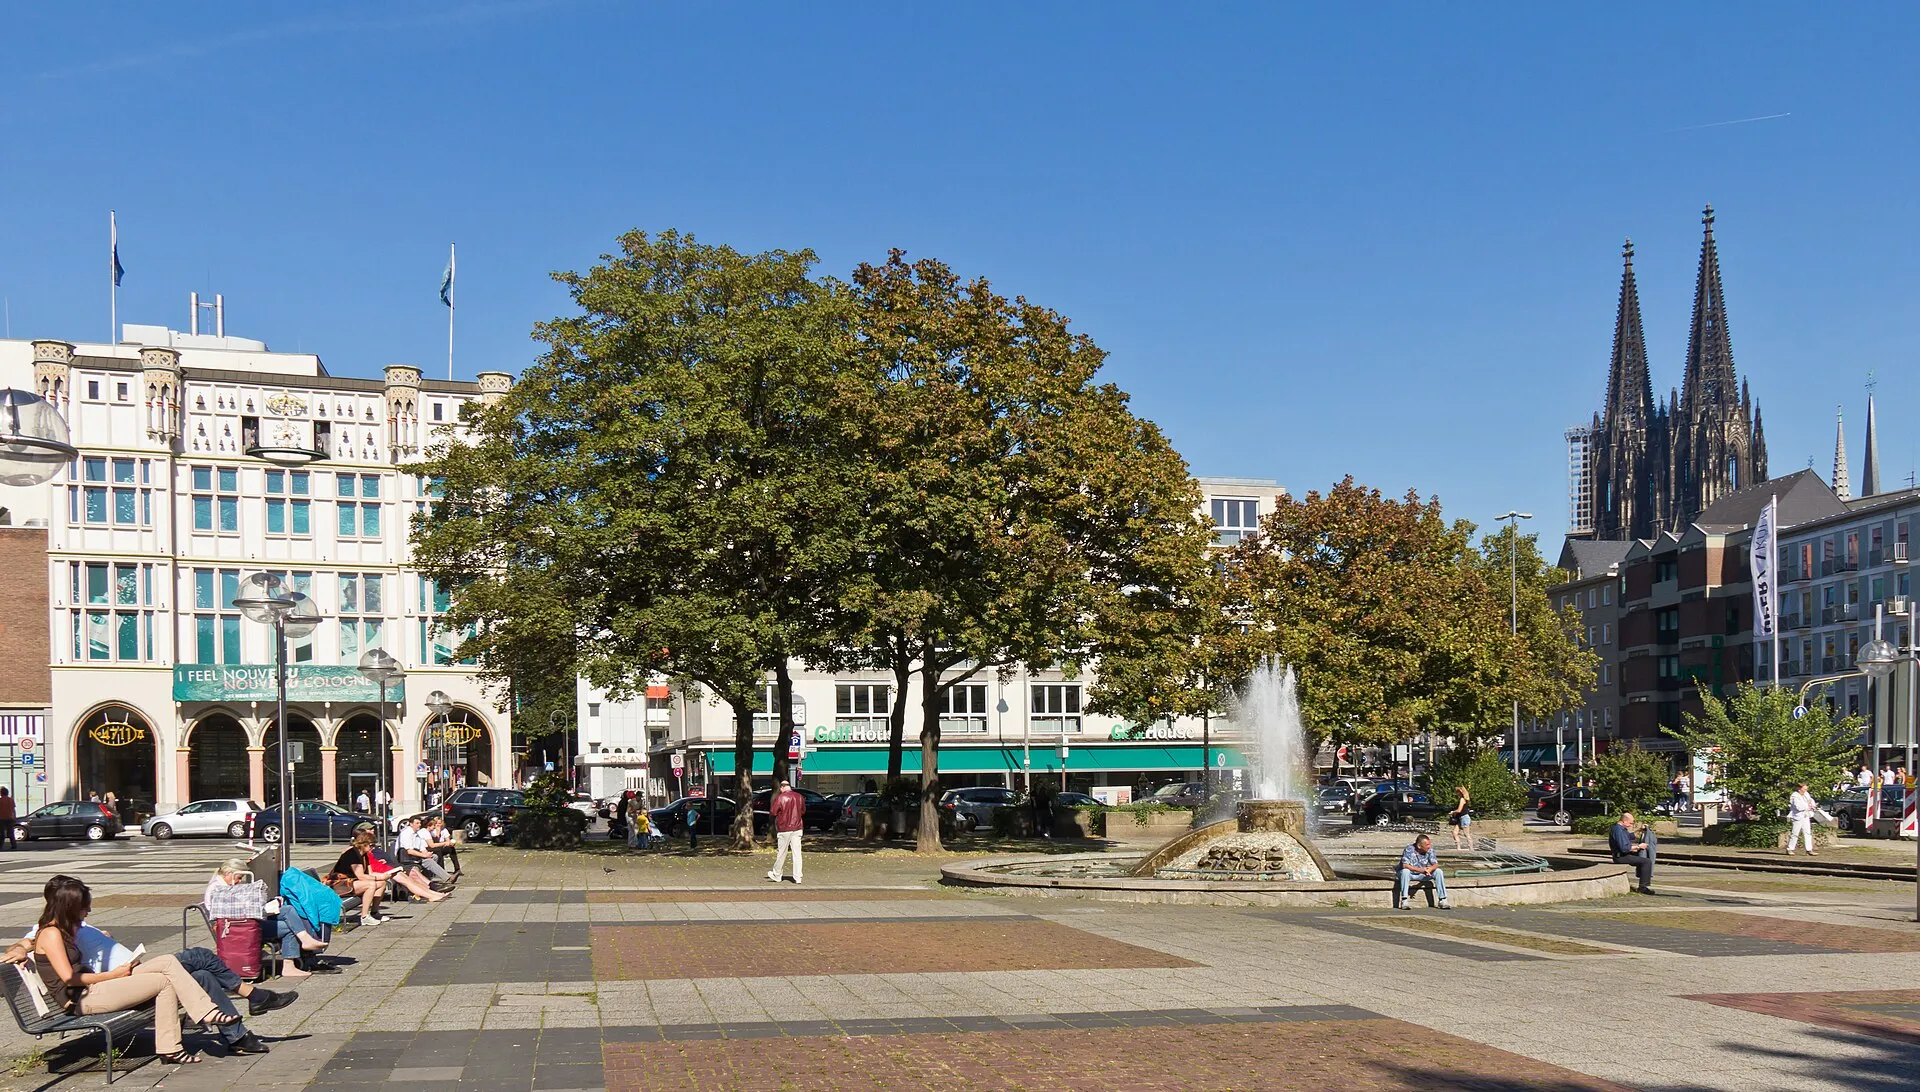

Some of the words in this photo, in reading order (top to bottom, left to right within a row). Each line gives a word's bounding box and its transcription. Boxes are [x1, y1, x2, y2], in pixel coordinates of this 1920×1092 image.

[178, 671, 183, 682] I
[188, 670, 219, 682] FEEL
[223, 668, 299, 680] NOUVEU
[223, 678, 300, 690] NOUVEU
[303, 676, 373, 688] COLOGNE
[100, 727, 131, 740] 4711
